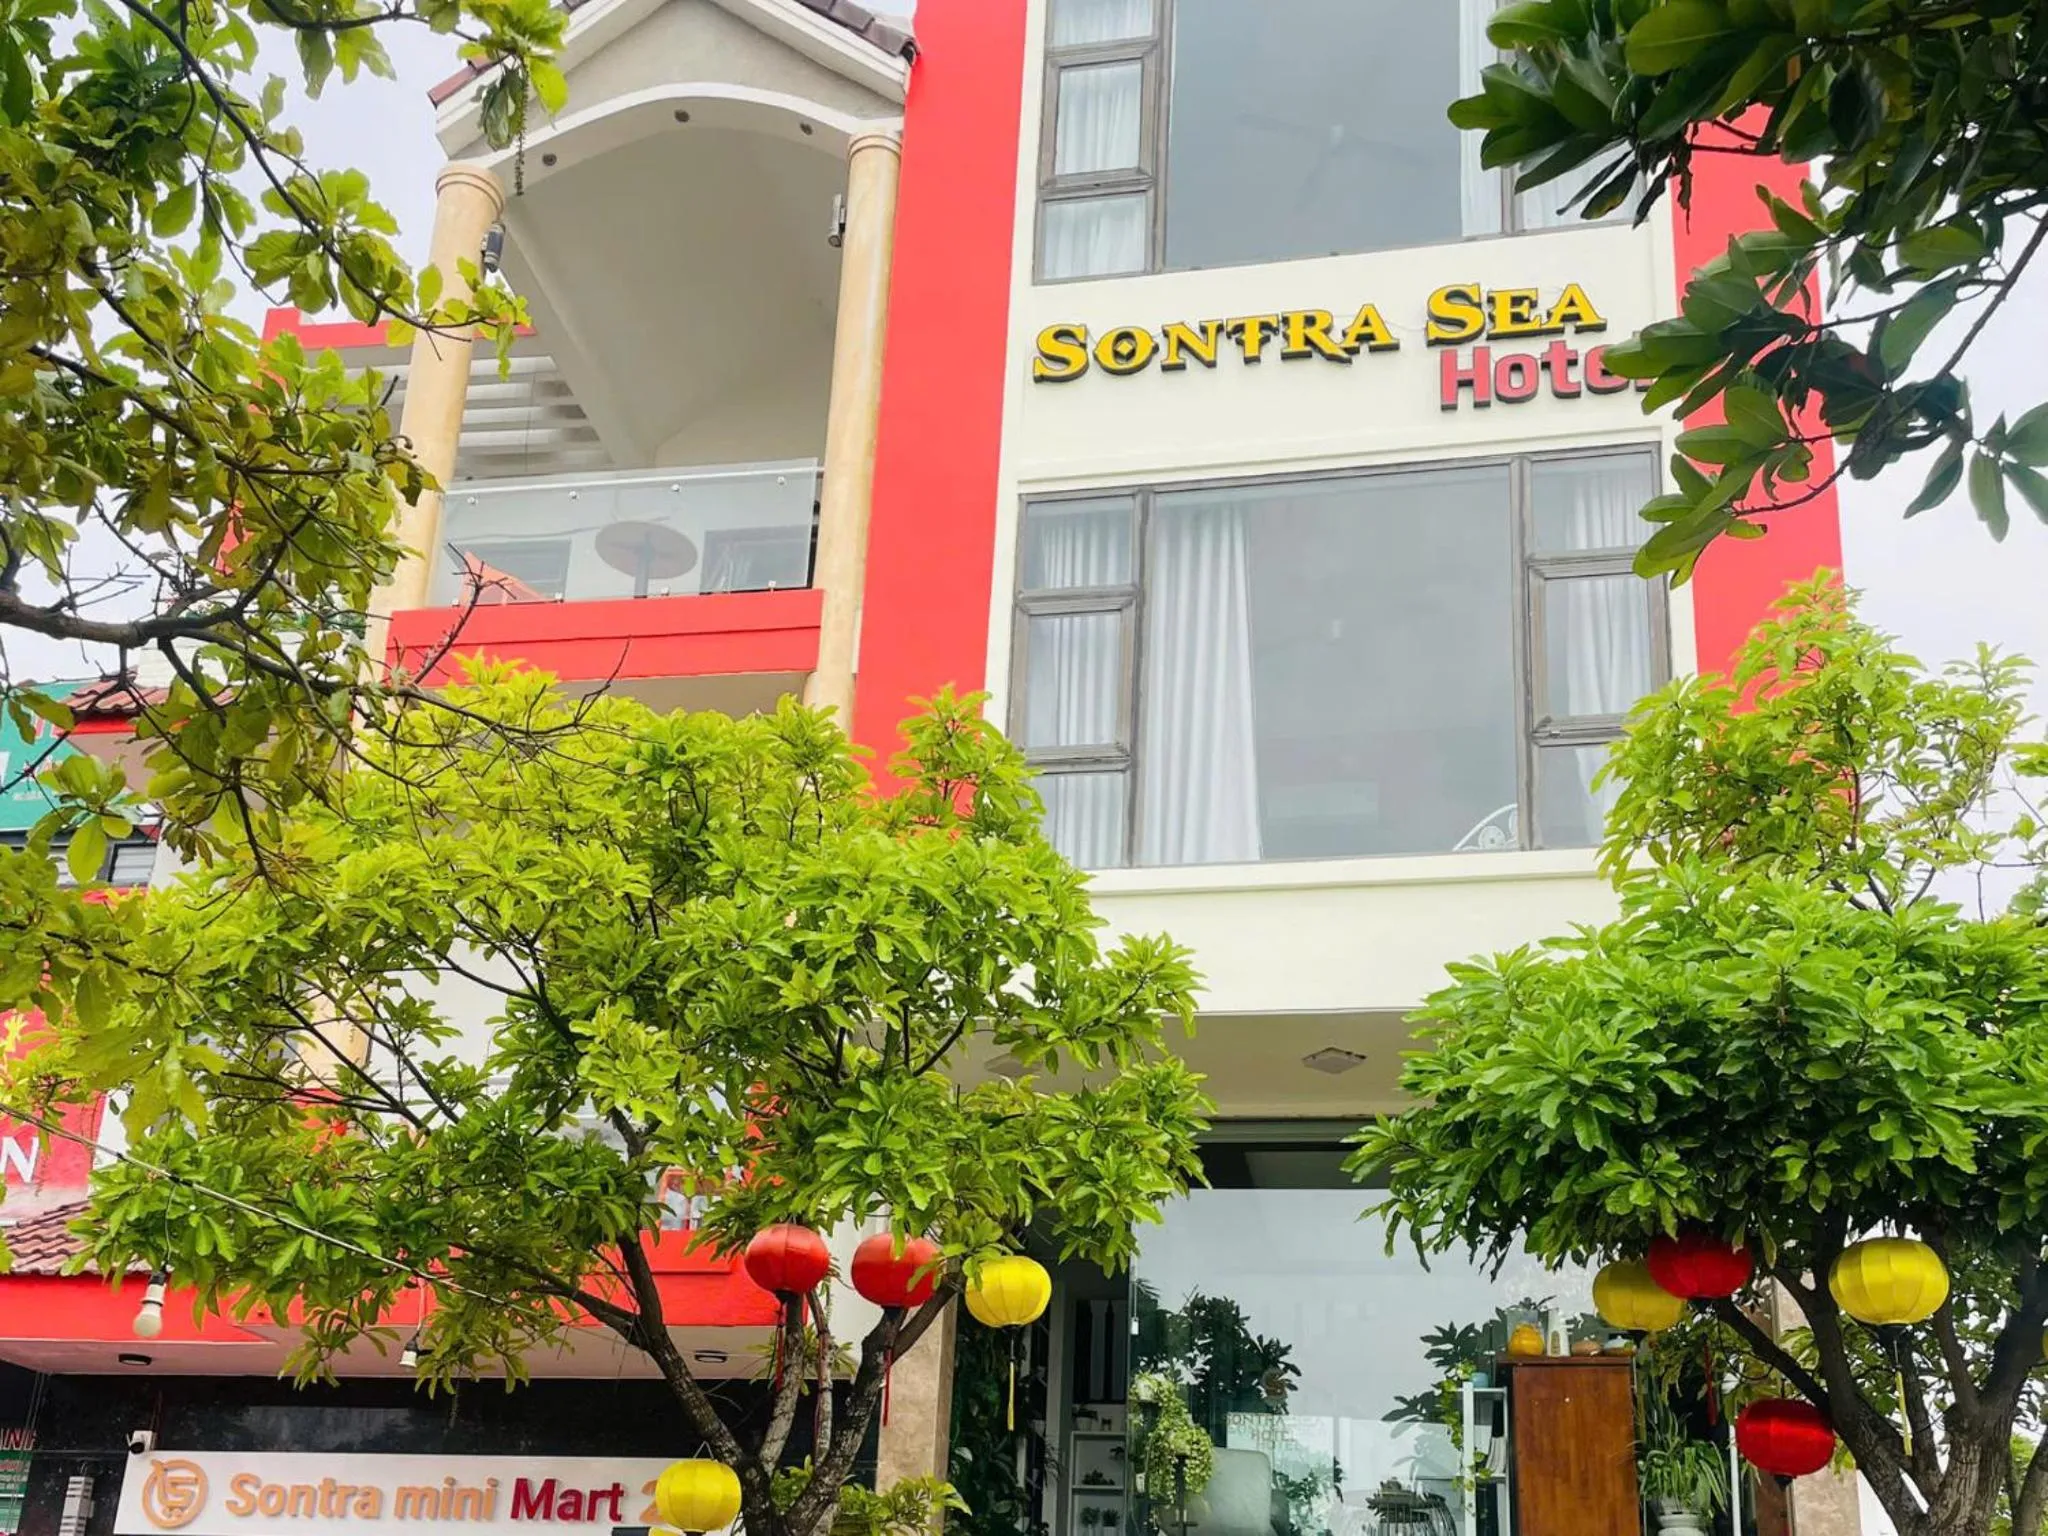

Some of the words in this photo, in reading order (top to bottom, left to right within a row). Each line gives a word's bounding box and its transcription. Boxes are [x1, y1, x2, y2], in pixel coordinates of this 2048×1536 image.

[1033, 303, 1400, 383] SONTRA
[1425, 283, 1608, 347] SEA
[1440, 340, 1655, 412] Hote
[225, 1472, 384, 1519] Sontra
[393, 1476, 499, 1520] mini
[509, 1477, 625, 1523] Mart
